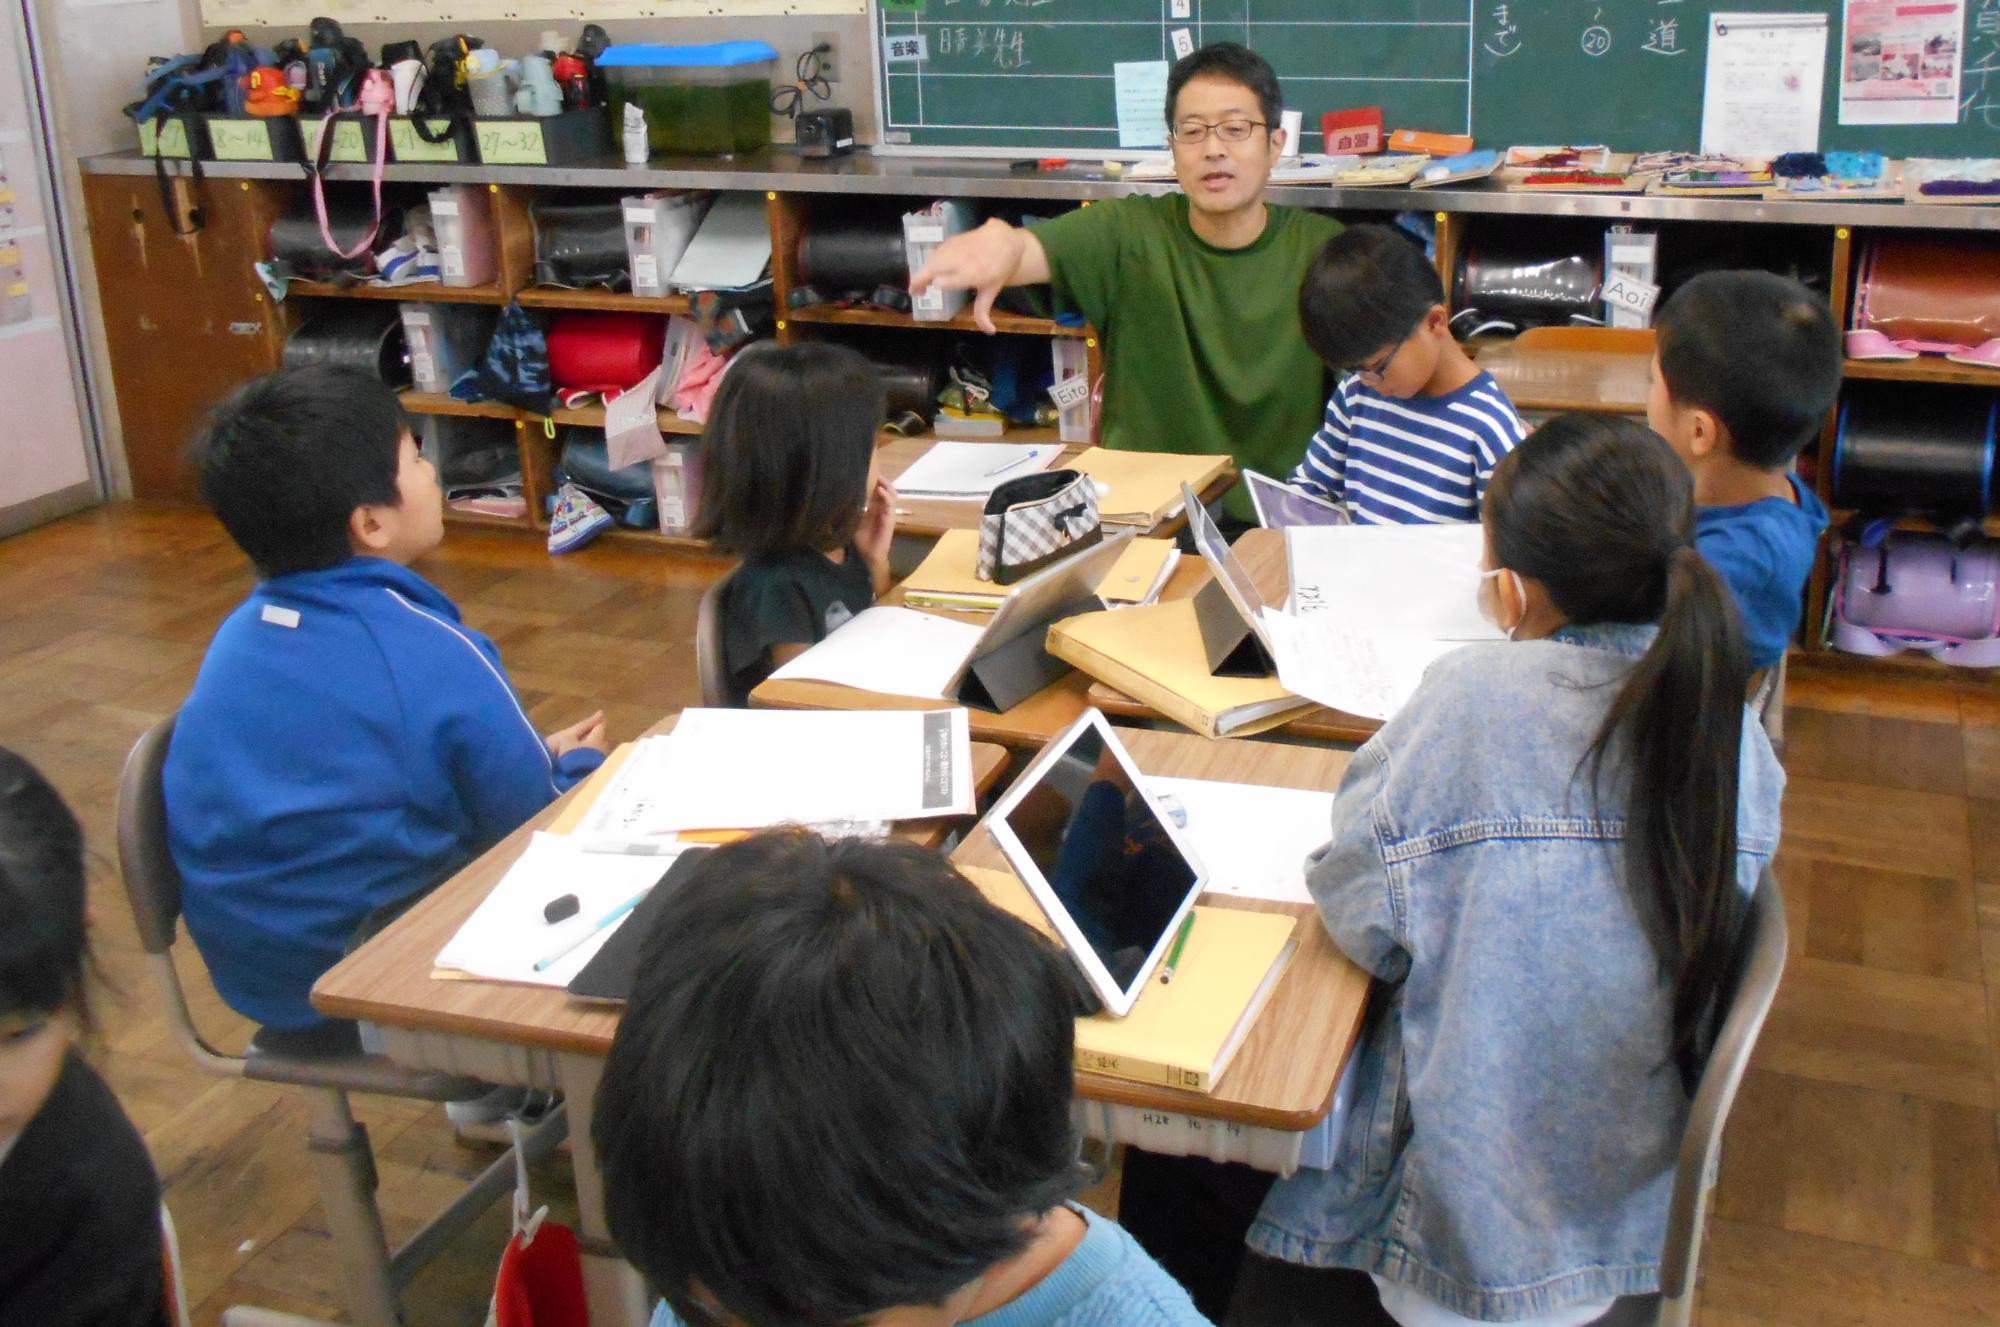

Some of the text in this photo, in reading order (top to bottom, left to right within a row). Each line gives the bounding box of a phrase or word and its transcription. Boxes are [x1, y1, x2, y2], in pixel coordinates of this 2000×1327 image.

[1176, 0, 1185, 9] 4
[891, 40, 920, 57] 音楽
[1338, 132, 1370, 150] 自習
[1607, 281, 1649, 307] Aoi
[1057, 385, 1088, 405] Eito
